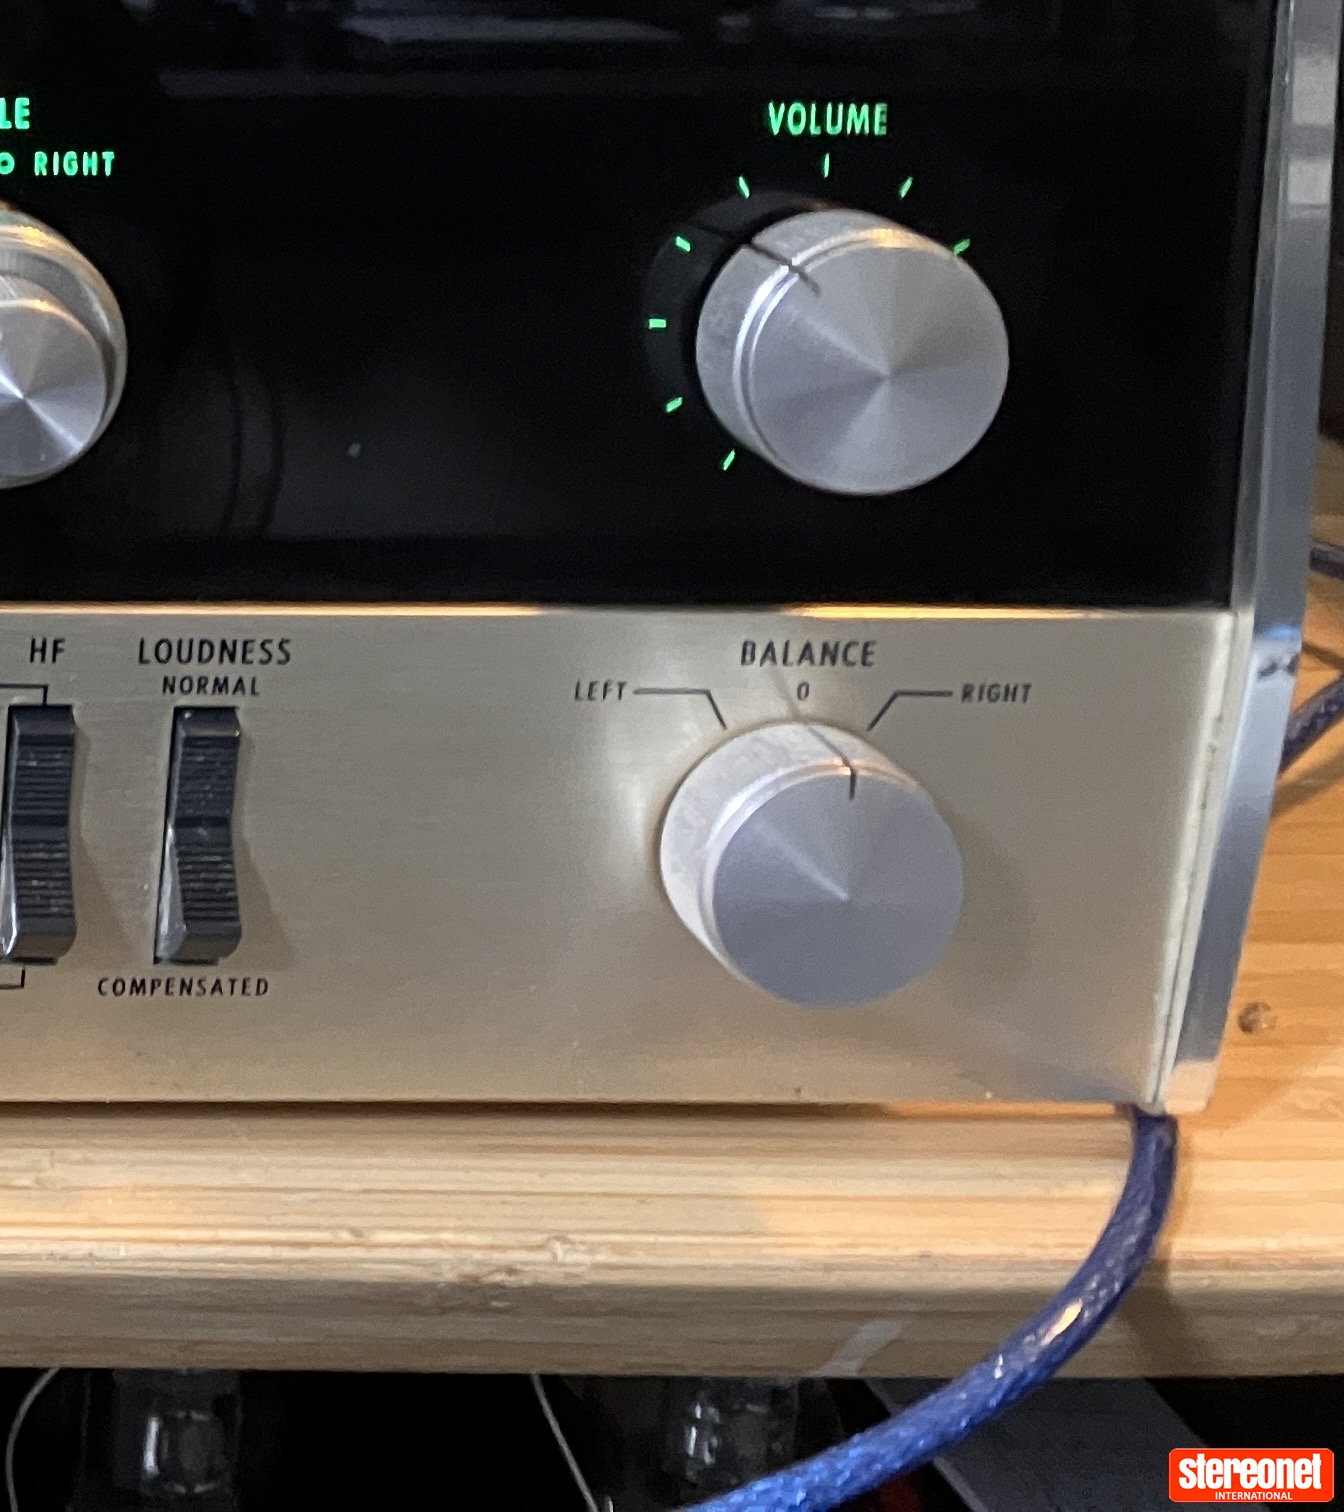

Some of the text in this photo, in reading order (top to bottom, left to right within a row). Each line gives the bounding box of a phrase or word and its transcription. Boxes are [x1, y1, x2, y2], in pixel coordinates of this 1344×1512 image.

[768, 101, 886, 135] VOLUME
[34, 151, 114, 176] RIGHT
[29, 638, 65, 663] HF
[138, 638, 291, 665] LOUDNESS
[741, 639, 877, 668] BALANCE
[162, 676, 260, 695] NORMAL
[575, 680, 626, 701] LEFT
[797, 682, 809, 700] 0
[961, 683, 1031, 703] RIGHT
[98, 978, 268, 996] COMPENSATED
